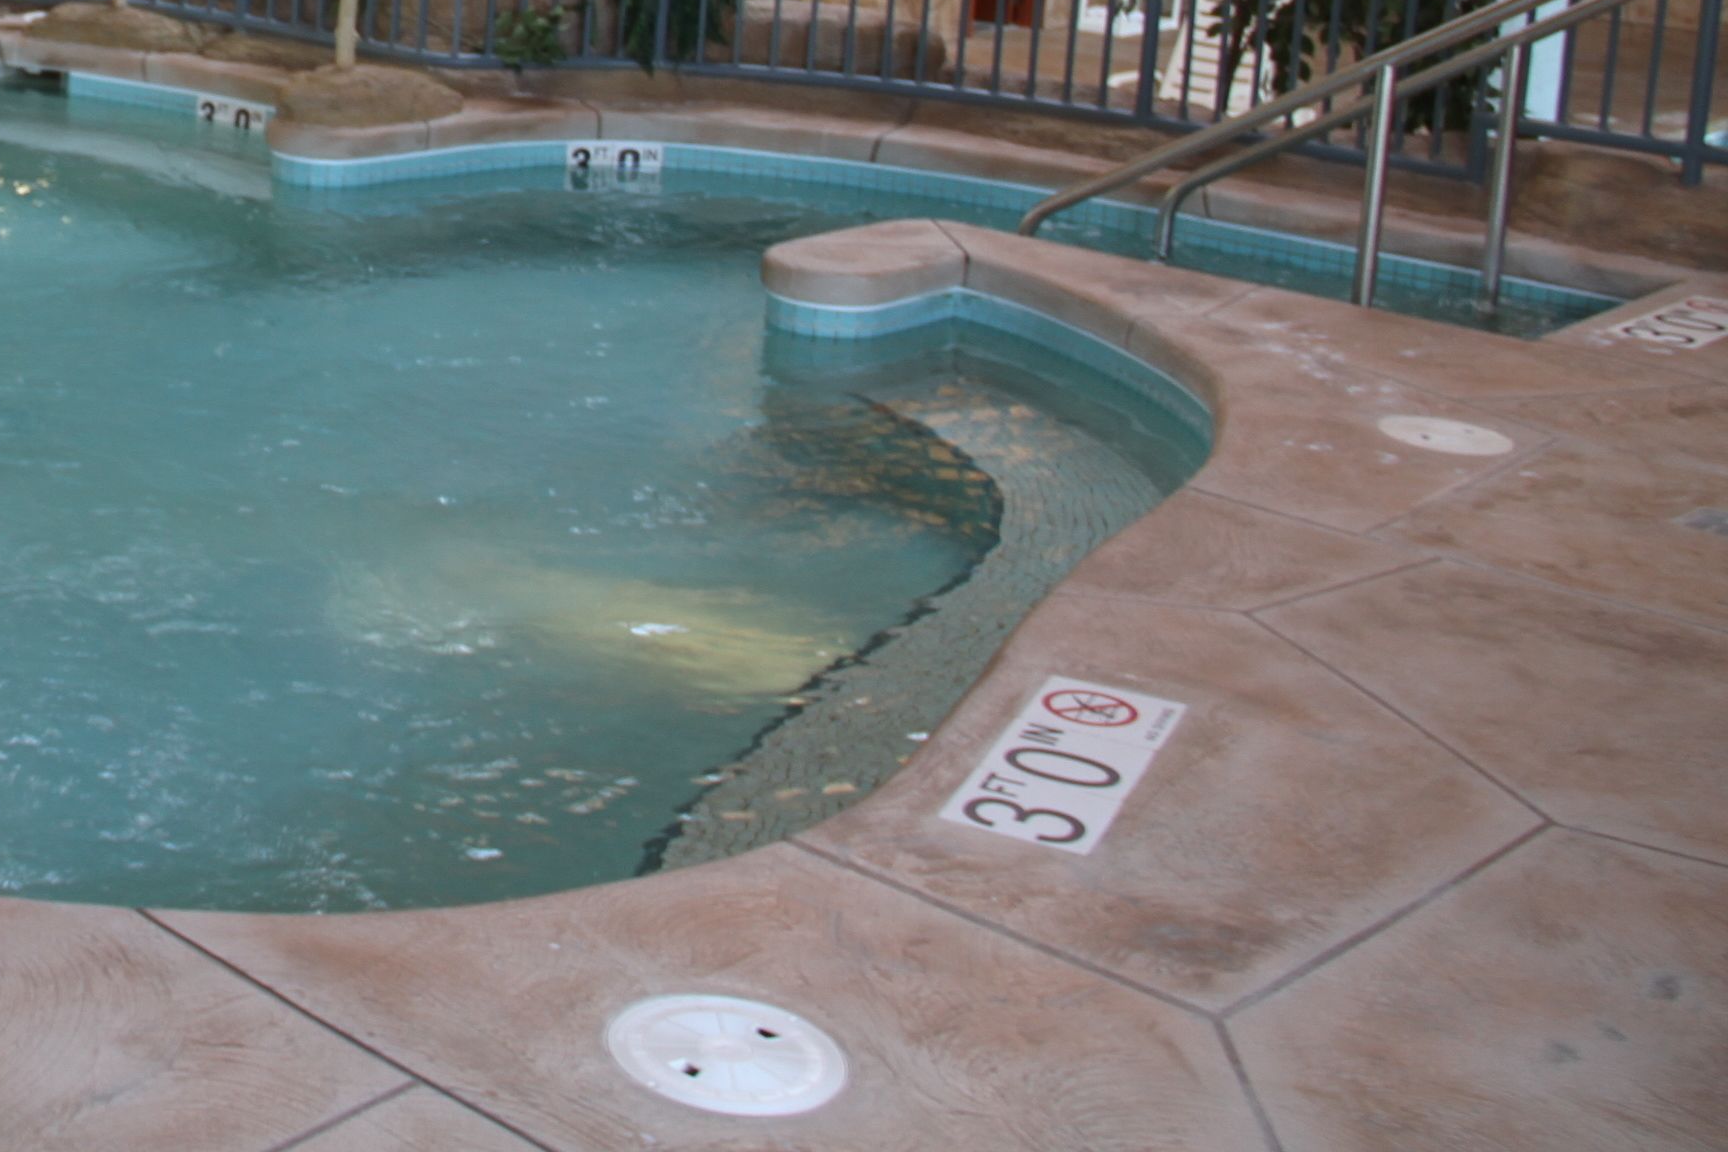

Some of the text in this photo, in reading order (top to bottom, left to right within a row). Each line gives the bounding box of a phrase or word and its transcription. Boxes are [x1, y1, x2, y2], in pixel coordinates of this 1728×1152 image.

[963, 722, 1121, 845] 3 FT 0 IN
